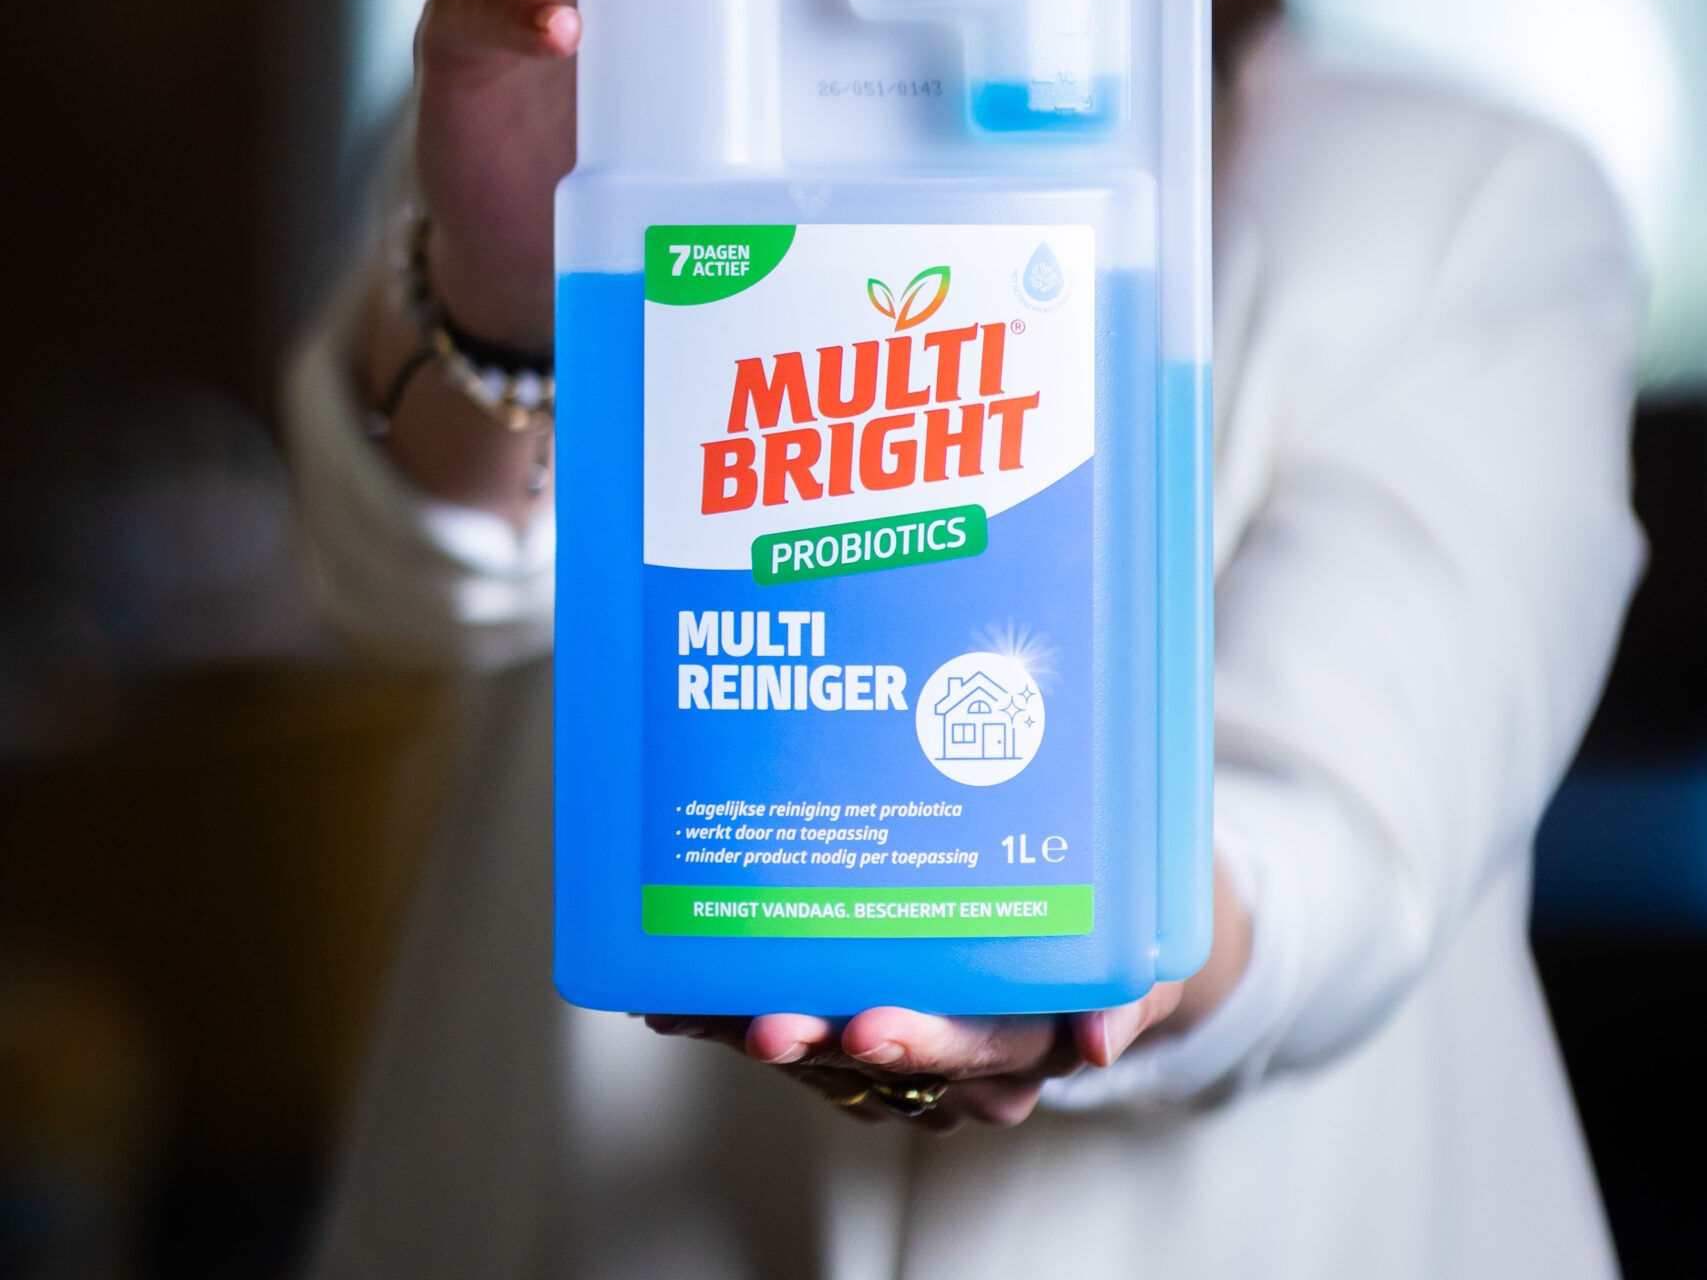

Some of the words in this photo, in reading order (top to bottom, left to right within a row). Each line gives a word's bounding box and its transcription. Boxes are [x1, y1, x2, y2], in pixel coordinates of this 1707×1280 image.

[669, 244, 691, 276] 7
[693, 244, 750, 260] DAGEN
[693, 261, 750, 277] ACTIEF
[727, 322, 1007, 433] MULTI
[700, 390, 1040, 515] BRIGHT
[771, 516, 967, 574] PROBIOTICS
[678, 611, 825, 657] MULTI
[678, 664, 909, 711] REINIGER
[685, 800, 766, 821] dagelijkse
[769, 801, 841, 822] reiniging
[844, 804, 877, 817] met
[879, 801, 963, 821] probiotica
[685, 824, 732, 840] werkt
[735, 824, 774, 841] door
[776, 828, 797, 841] na
[800, 825, 889, 845] toepassing
[1001, 833, 1036, 864] 1L
[685, 848, 742, 864] minder
[743, 848, 808, 868] product
[811, 849, 857, 869] nodig
[859, 851, 889, 869] per
[891, 848, 979, 869] toepassing
[693, 901, 759, 918] REINIGT
[762, 902, 851, 919] VANDAAG.
[854, 902, 957, 919] BESCHERMT
[959, 902, 993, 918] EEN
[995, 901, 1048, 918] WEEK!
